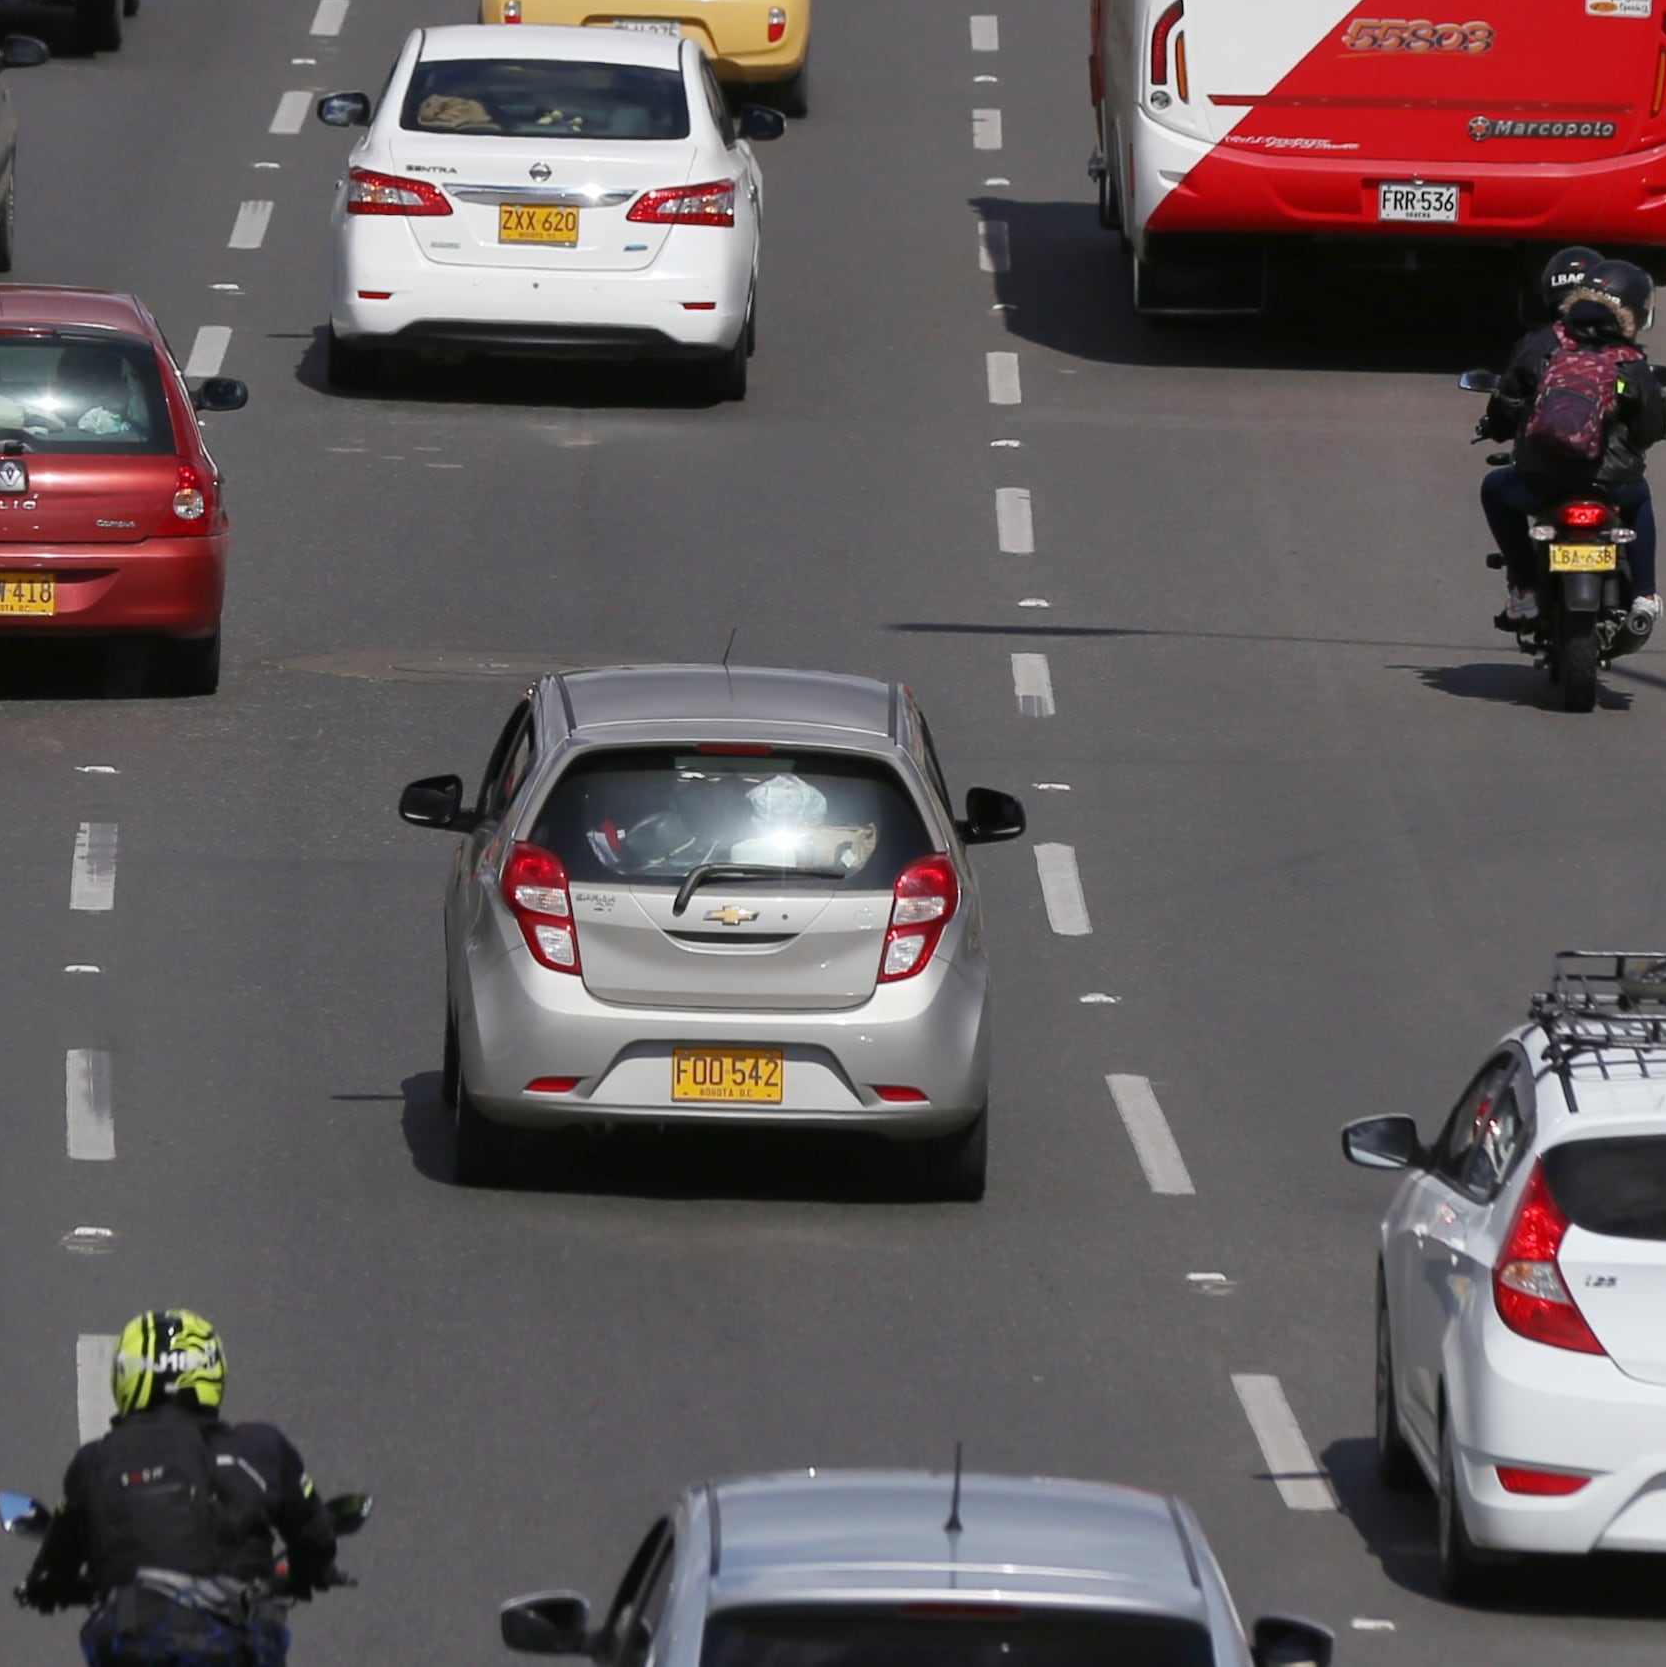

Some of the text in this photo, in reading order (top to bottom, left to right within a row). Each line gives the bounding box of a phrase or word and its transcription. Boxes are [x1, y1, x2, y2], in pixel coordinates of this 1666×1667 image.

[1342, 18, 1495, 54] 55803
[1495, 119, 1615, 137] Marcopolo
[405, 164, 458, 176] SENTRA
[502, 209, 576, 233] ZXX 620
[732, 1058, 779, 1089] 542
[699, 1087, 734, 1098] BOGOTA
